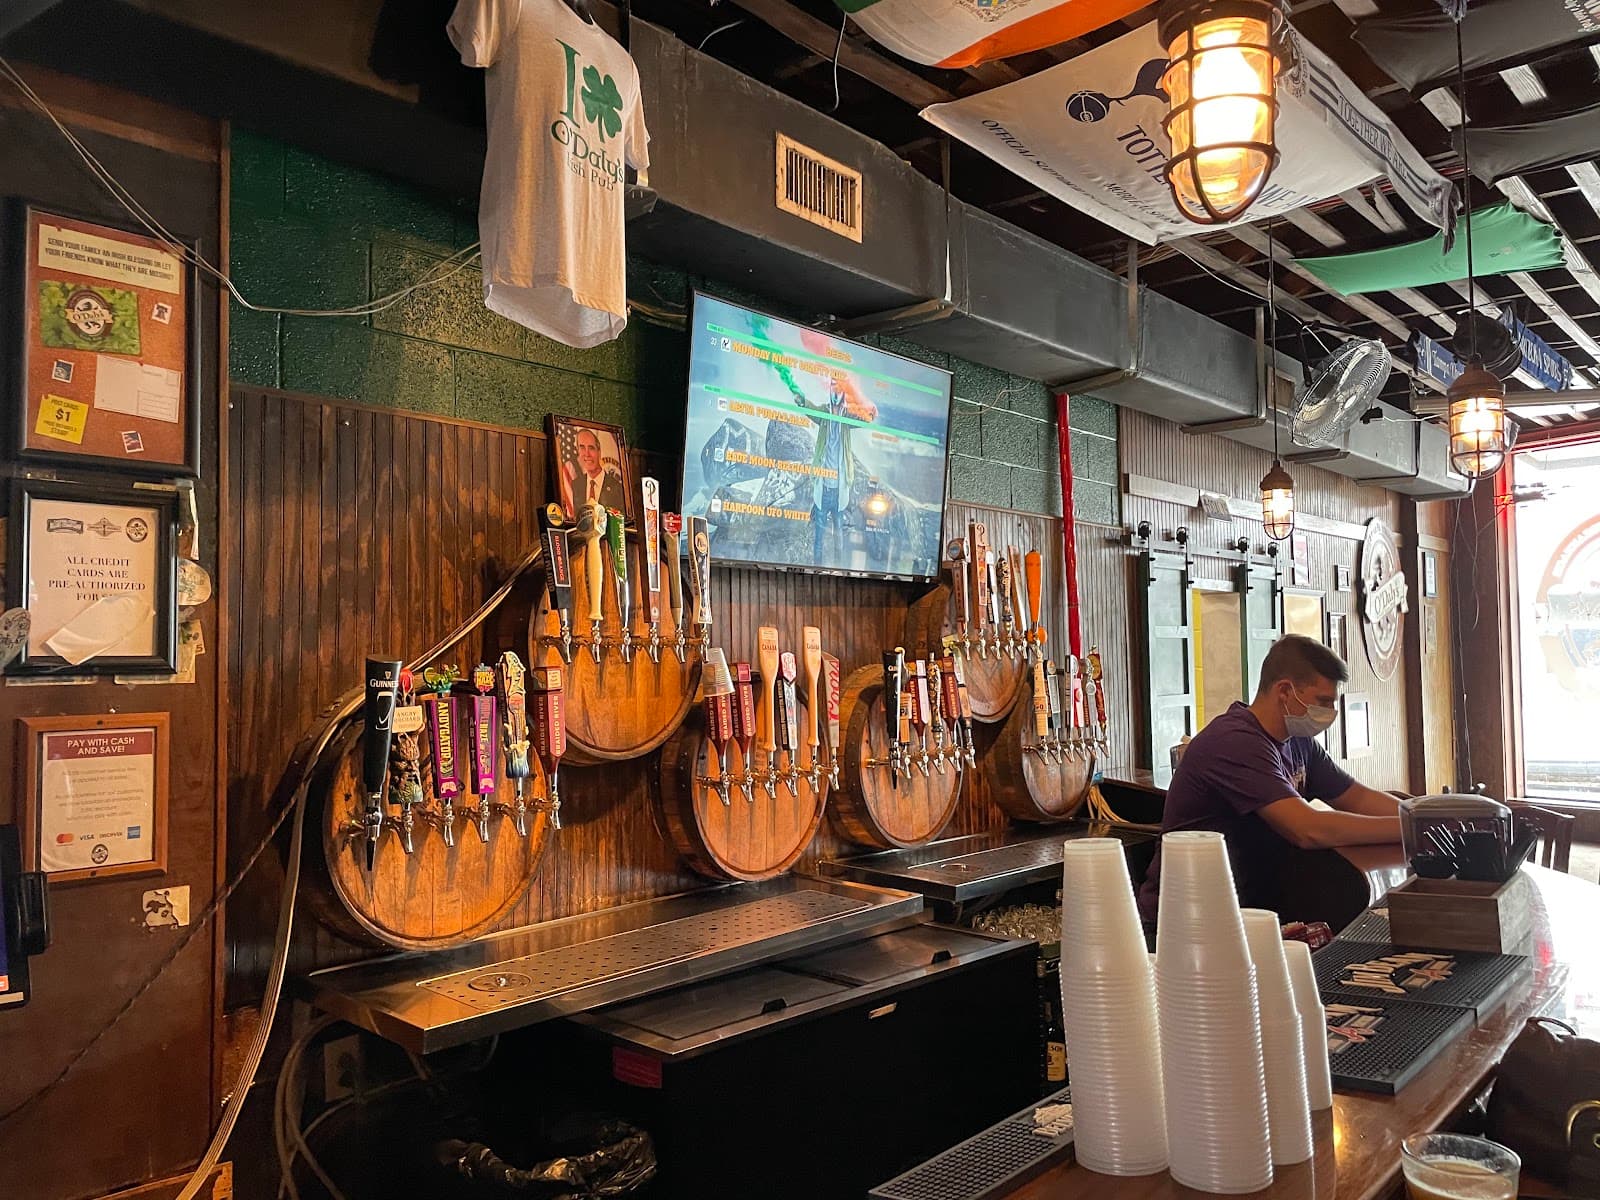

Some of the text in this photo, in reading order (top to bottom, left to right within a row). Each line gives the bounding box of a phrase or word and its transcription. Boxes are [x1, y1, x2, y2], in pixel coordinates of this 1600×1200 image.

[555, 38, 581, 128] I
[1338, 95, 1380, 148] TOGETHER
[1380, 131, 1393, 162] WE
[551, 120, 624, 184] O'Daly's
[1116, 124, 1171, 190] TOTTE
[591, 169, 614, 192] Pub
[105, 260, 121, 270] WHAT
[122, 263, 136, 273] THEY
[732, 342, 770, 361] MONDAY
[56, 408, 71, 422] $1
[749, 454, 776, 469] MOON
[813, 465, 838, 480] WHITE
[723, 501, 811, 522] HARPOON UFO WHITE
[617, 523, 625, 562] Heineken
[67, 556, 130, 567] ALL CREDIT
[67, 568, 129, 579] CARDS ARE
[48, 580, 146, 591] PRE-AUTHORIZED
[76, 592, 99, 601] FOR
[370, 678, 399, 688] GUINNE
[438, 702, 453, 760] ANDYGATOR
[67, 736, 135, 748] PAY WITH CASH
[77, 746, 98, 755] AND
